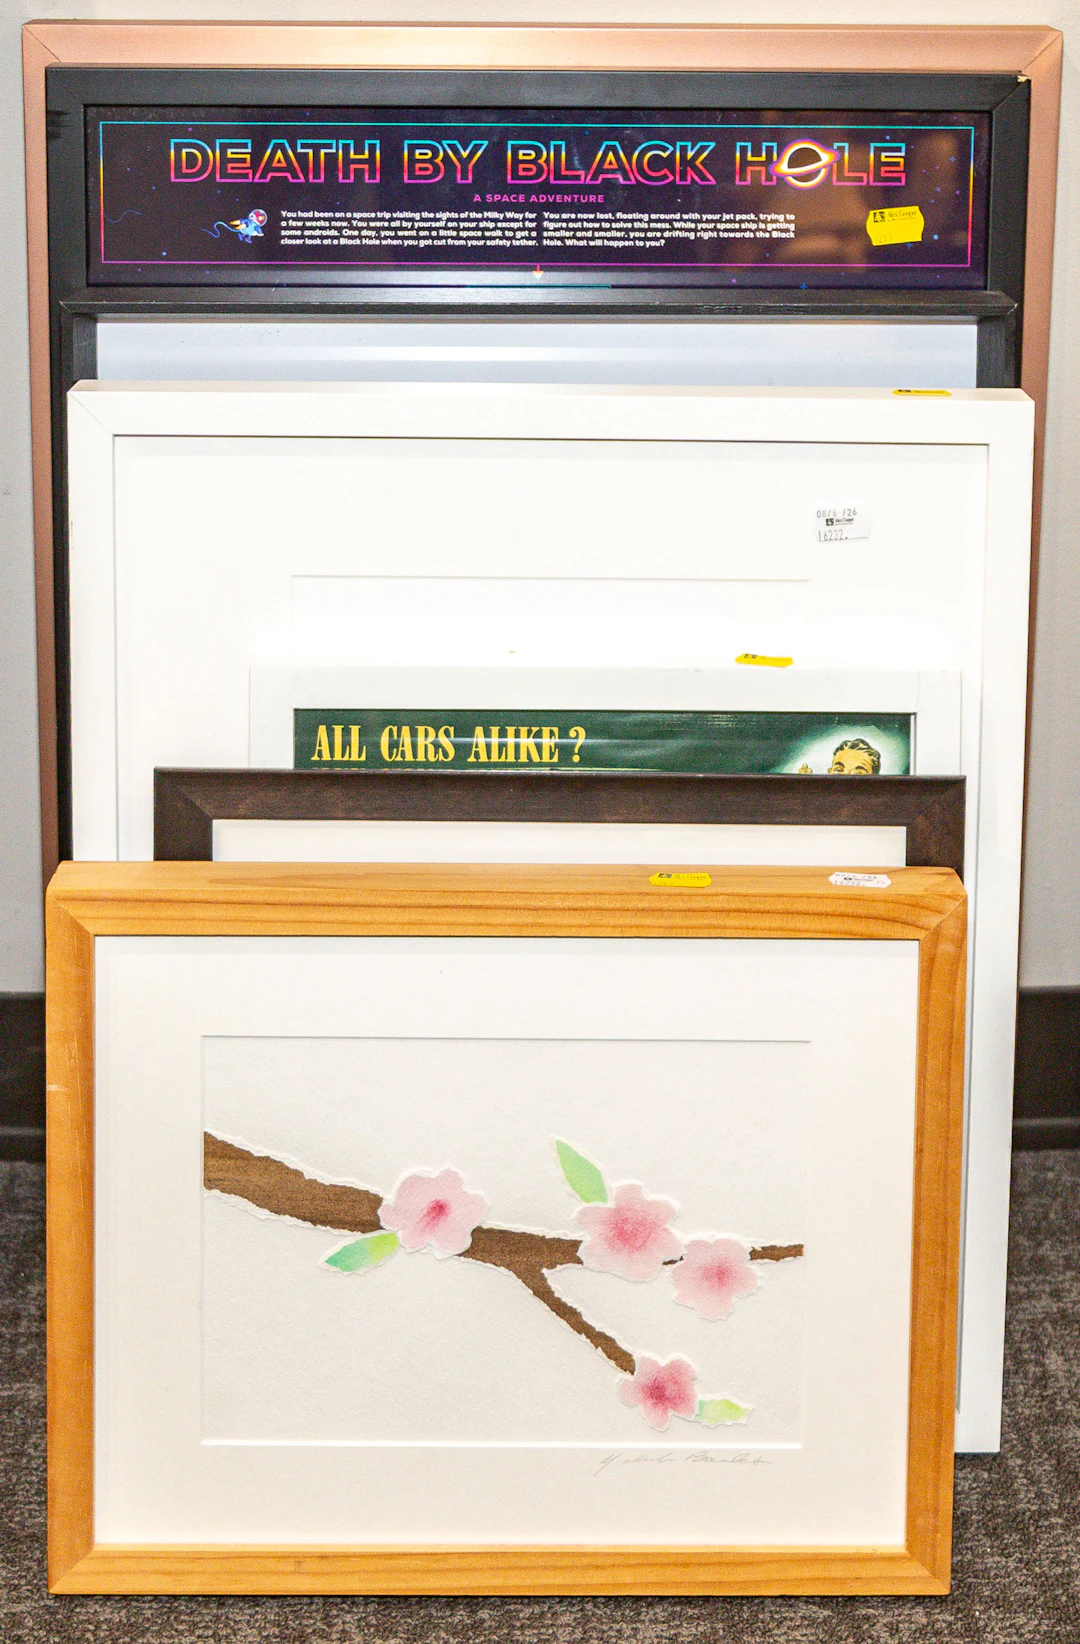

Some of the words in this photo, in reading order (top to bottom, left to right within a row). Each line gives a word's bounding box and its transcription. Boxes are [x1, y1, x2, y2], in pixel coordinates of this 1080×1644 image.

[170, 139, 380, 183] DEATH
[404, 140, 489, 184] BY
[507, 140, 716, 185] BLACK
[735, 138, 906, 189] HOLE
[473, 194, 481, 203] A
[485, 194, 526, 203] SPACE
[529, 194, 605, 203] ADVENTURE
[281, 210, 297, 218] You
[298, 210, 313, 218] had
[314, 210, 333, 218] been
[353, 212, 375, 220] space
[377, 211, 391, 220] trip
[392, 211, 420, 220] visiting
[436, 211, 459, 220] sights
[470, 211, 482, 219] the
[484, 211, 504, 220] Milky
[505, 211, 523, 221] Way
[616, 212, 649, 221] floating
[682, 212, 700, 220] with
[702, 214, 721, 222] your
[723, 213, 735, 222] jet
[760, 213, 784, 222] trying
[288, 219, 303, 227] few
[305, 219, 329, 227] weeks
[402, 220, 412, 229] by
[414, 220, 446, 229] yourself
[479, 220, 495, 229] ship
[497, 220, 524, 230] except
[543, 221, 567, 230] figure
[697, 223, 715, 231] your
[717, 223, 739, 231] space
[741, 222, 757, 231] ship
[767, 222, 795, 231] getting
[516, 230, 528, 239] get
[663, 230, 695, 239] drifting
[697, 231, 717, 240] right
[419, 238, 432, 247] got
[486, 239, 511, 247] safety
[604, 239, 634, 248] happen
[645, 239, 665, 248] you?
[310, 725, 366, 761] ALL
[380, 725, 455, 762] CARS
[467, 726, 559, 763] ALIKE
[568, 726, 586, 763] ?
